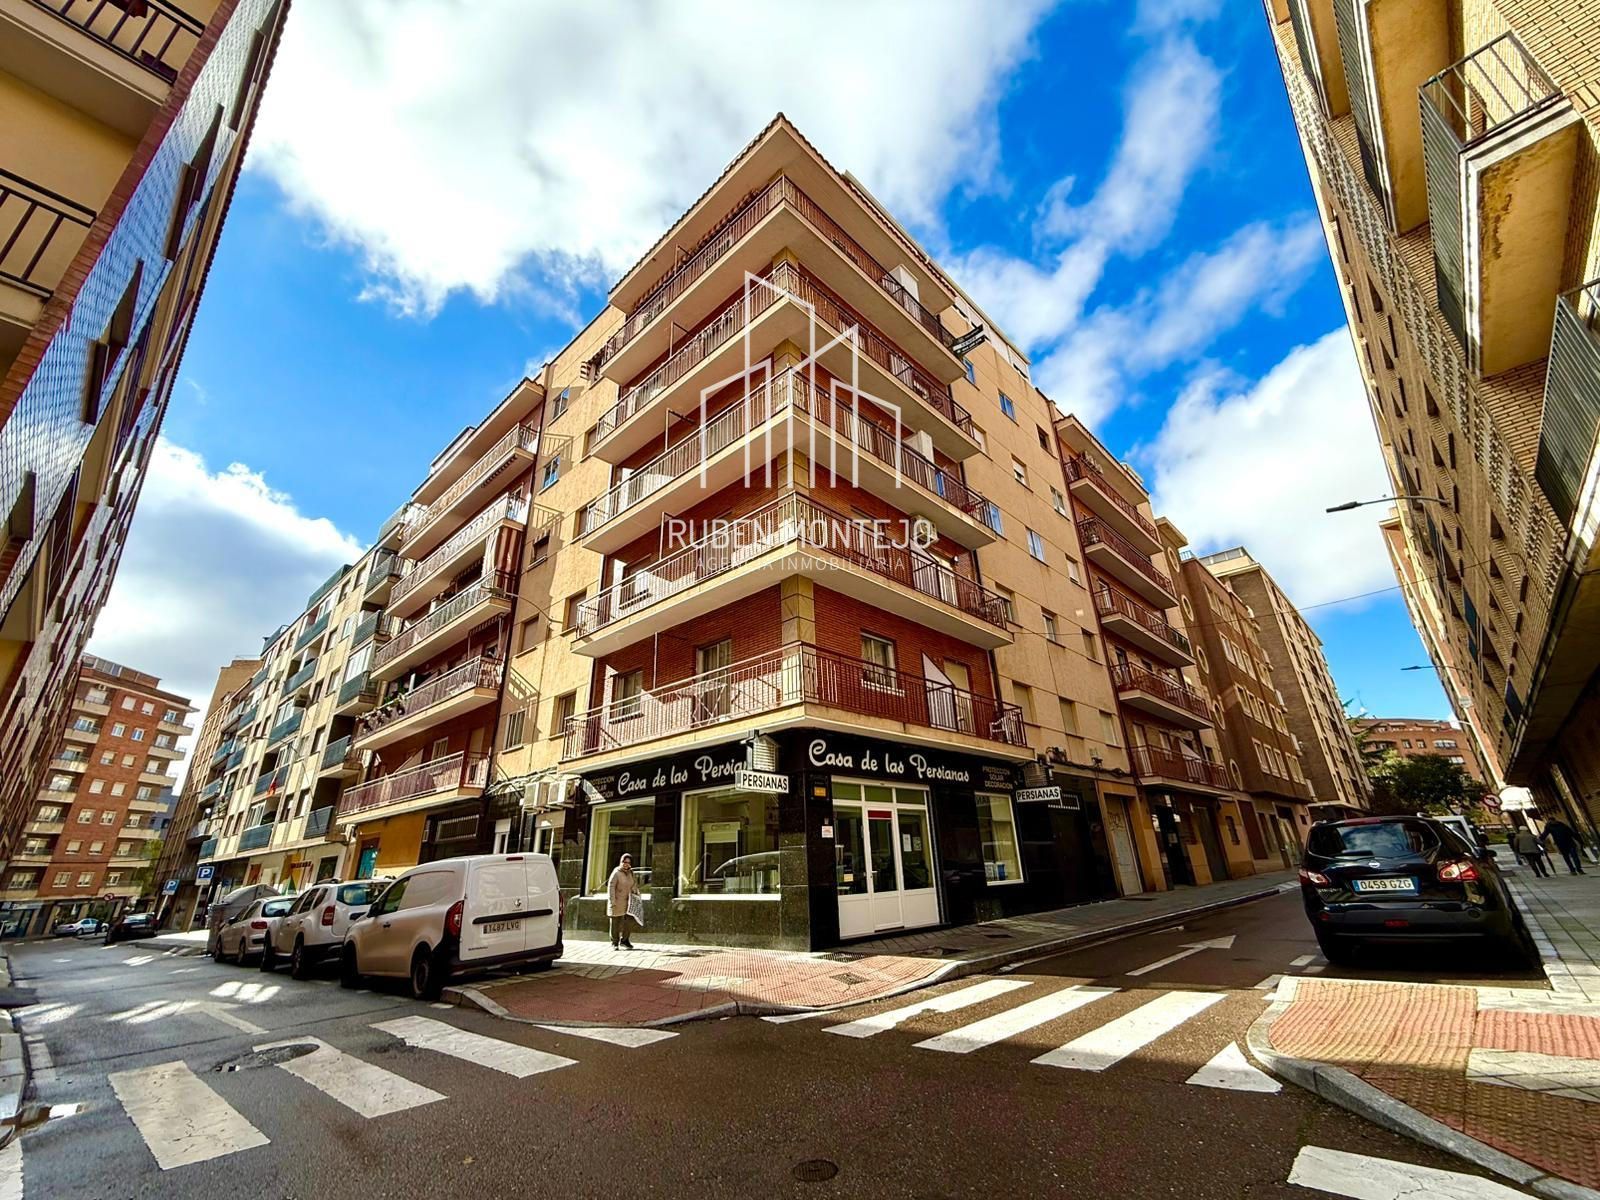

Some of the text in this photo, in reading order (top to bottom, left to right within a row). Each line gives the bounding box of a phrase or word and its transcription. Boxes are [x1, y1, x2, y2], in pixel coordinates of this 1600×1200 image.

[808, 739, 970, 782] Casa de las Persianas
[617, 772, 647, 795] Casa
[652, 768, 666, 789] de
[670, 765, 688, 785] las
[742, 773, 788, 792] PERSIANAS
[1016, 788, 1059, 801] PERSIANAS
[201, 868, 210, 877] P
[166, 881, 175, 889] P
[1360, 879, 1411, 890] 0459 GZG
